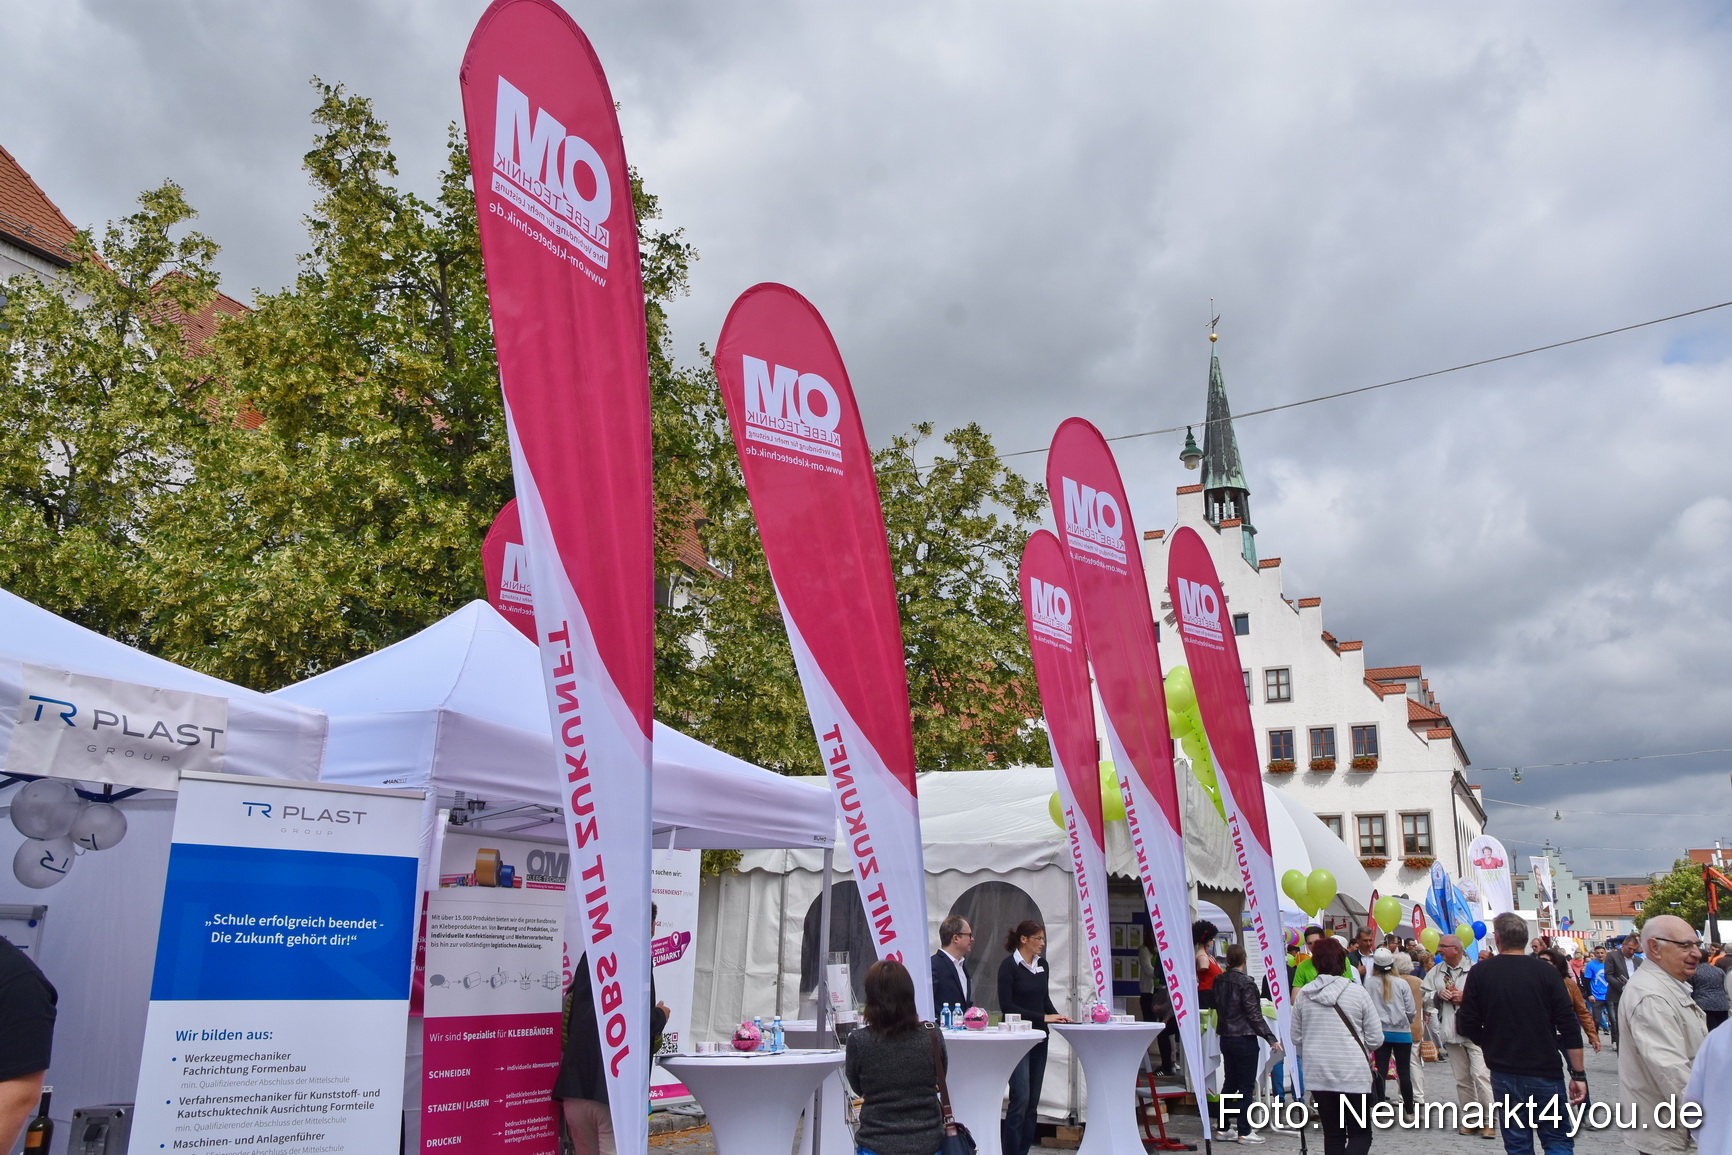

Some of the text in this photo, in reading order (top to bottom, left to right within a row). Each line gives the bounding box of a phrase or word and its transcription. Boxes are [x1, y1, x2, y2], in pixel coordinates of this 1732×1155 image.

[93, 709, 224, 749] PLAST
[87, 744, 171, 762] GROUP
[283, 806, 367, 825] PLAST
[280, 827, 333, 836] GROUP
[526, 849, 570, 877] OM
[205, 913, 256, 927] „Schule
[259, 915, 326, 930] erfolgreich
[329, 917, 377, 929] beendet
[211, 931, 231, 943] Die
[234, 931, 284, 944] Zukunft
[287, 933, 327, 948] gehört
[652, 950, 681, 964] EUMARKT
[175, 1029, 273, 1042] Wir bilden aus:
[431, 1026, 554, 1042] Wir sind Spezialist für KLEBEBÄNDER
[184, 1051, 292, 1064] Werkzeugmechaniker
[183, 1064, 307, 1077] Fachrichtung Formenbau
[429, 1068, 471, 1079] SCHNEIDEN
[181, 1075, 350, 1089] min. Qualifizierender Abschluss der Mittelschule
[179, 1088, 381, 1106] Verfahrensmechaniker für Kunststoff- und
[177, 1101, 375, 1119] Kautschuktechnik Ausrichtung Formteile
[428, 1102, 461, 1113] STANZEN
[466, 1099, 489, 1109] LASERN
[175, 1116, 347, 1132] min. Qualifizierender Abschluss der Mittelschule
[173, 1131, 326, 1149] Maschinen- und Anlagenführer
[427, 1136, 461, 1148] DRUCKEN
[291, 1146, 301, 1154] der
[302, 1143, 344, 1153] Mittelschule
